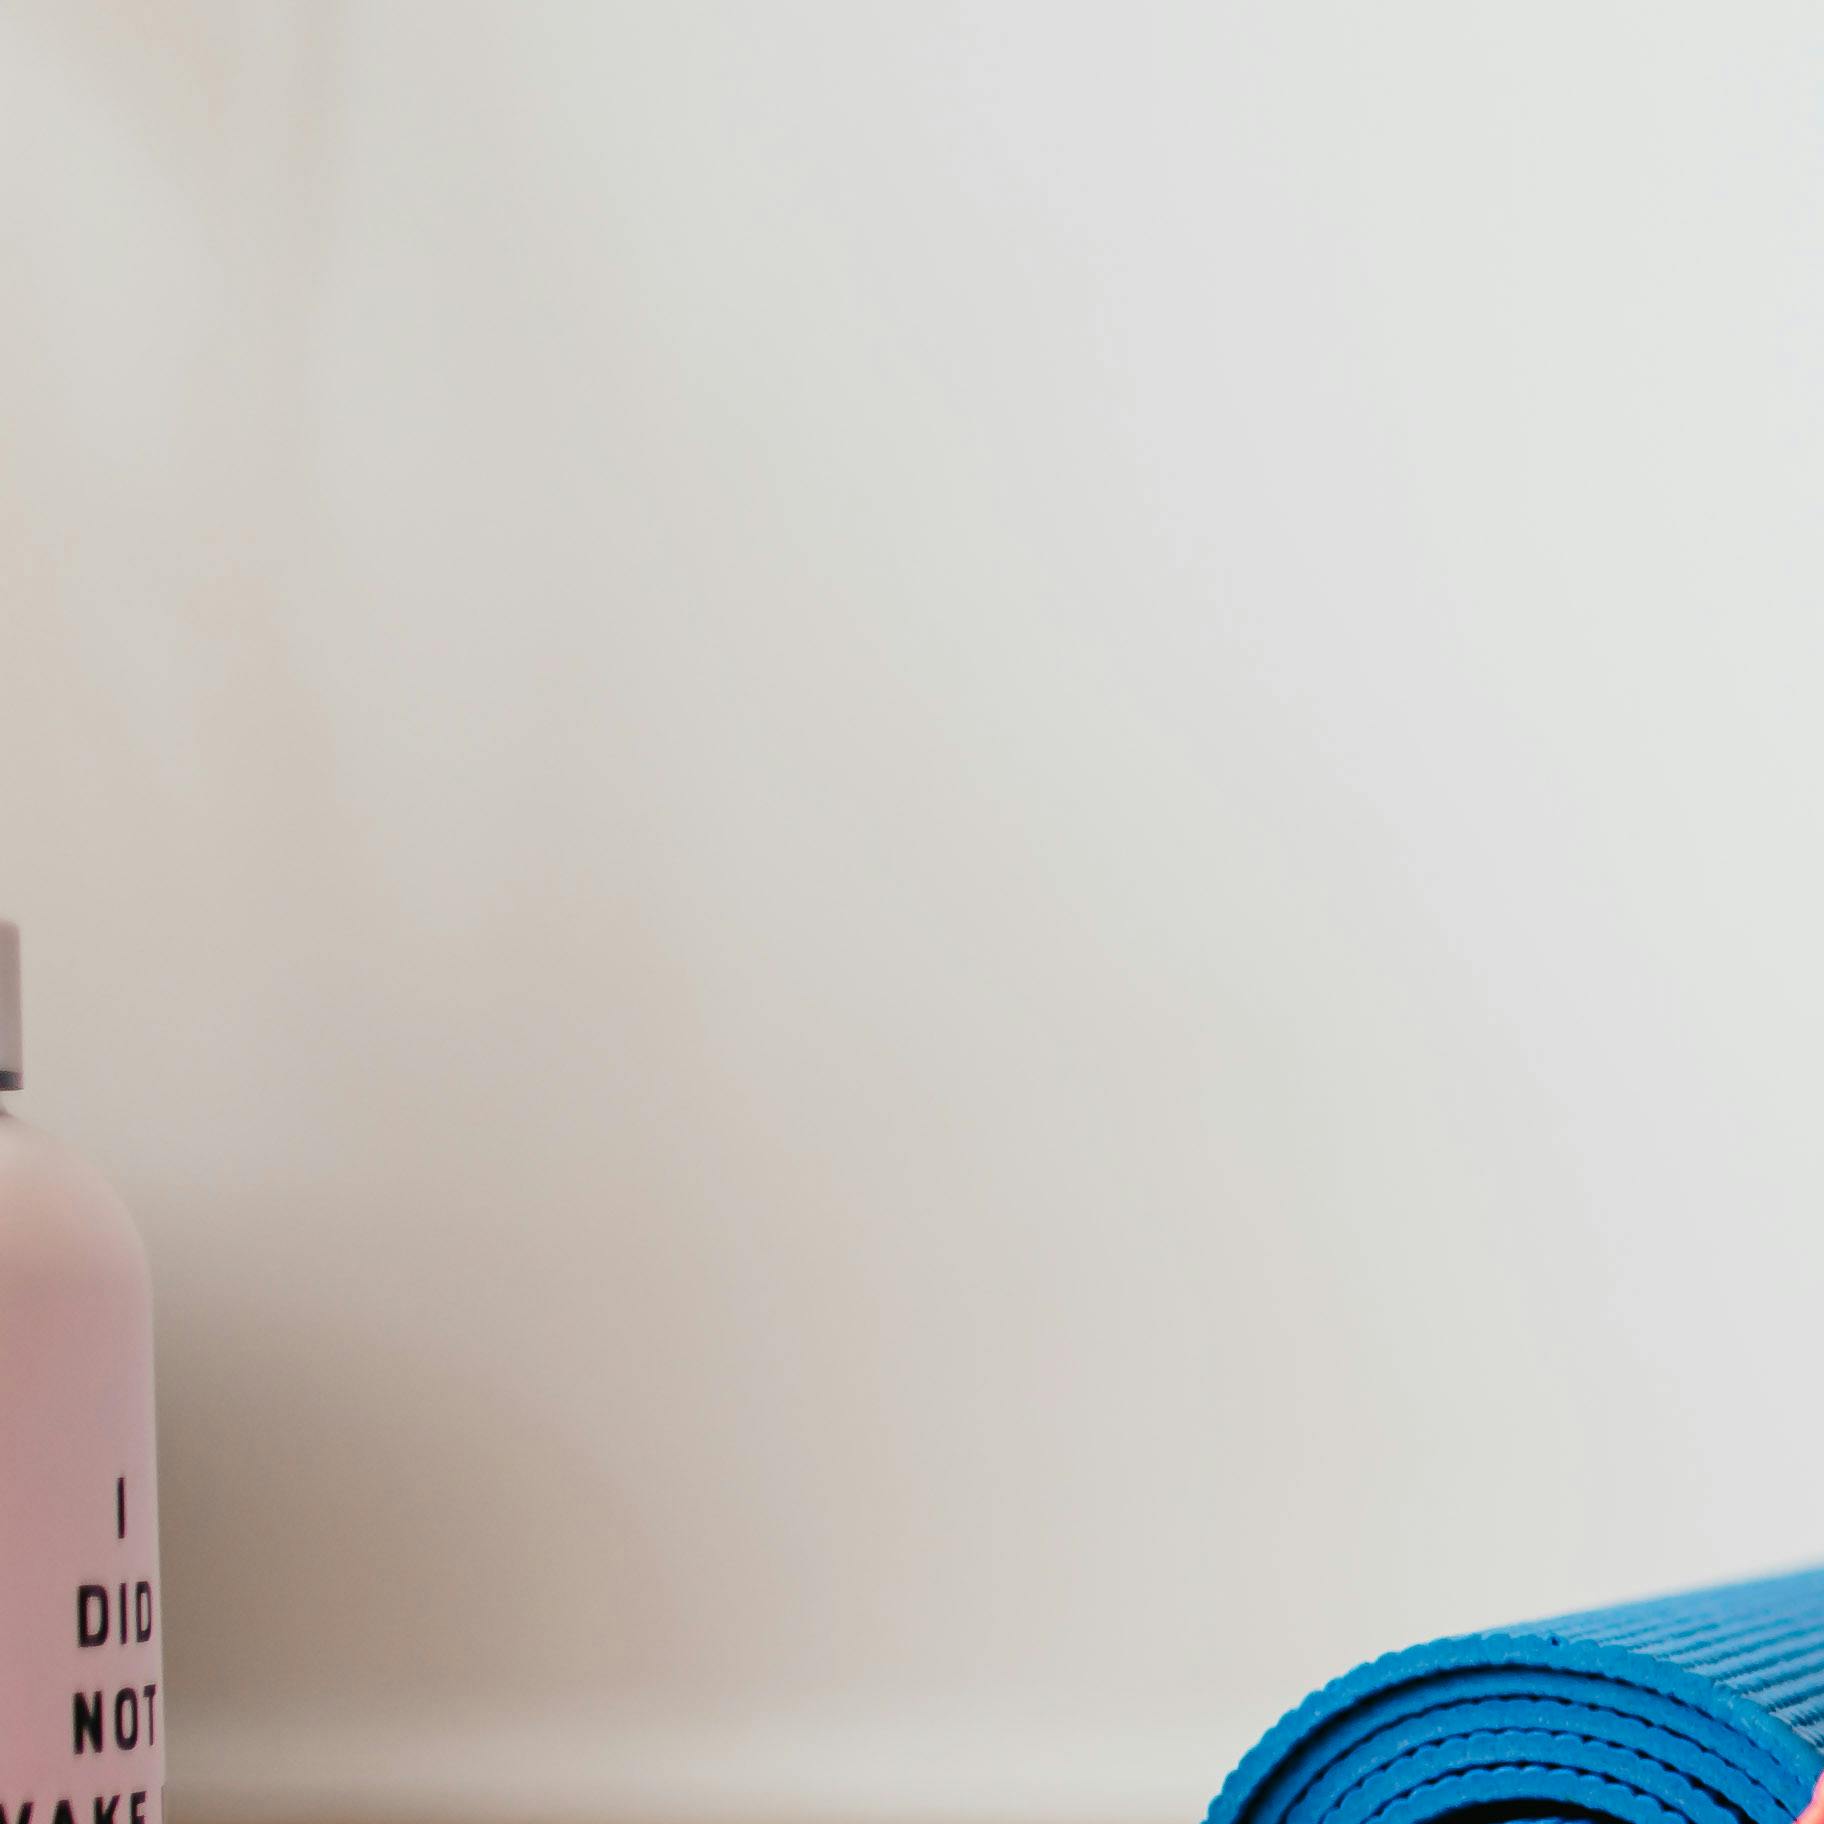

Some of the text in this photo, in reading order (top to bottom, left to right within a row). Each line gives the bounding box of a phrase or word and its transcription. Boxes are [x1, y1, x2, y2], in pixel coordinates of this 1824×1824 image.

[116, 1476, 127, 1540] I
[77, 1580, 153, 1649] DID
[72, 1684, 157, 1755] NOT
